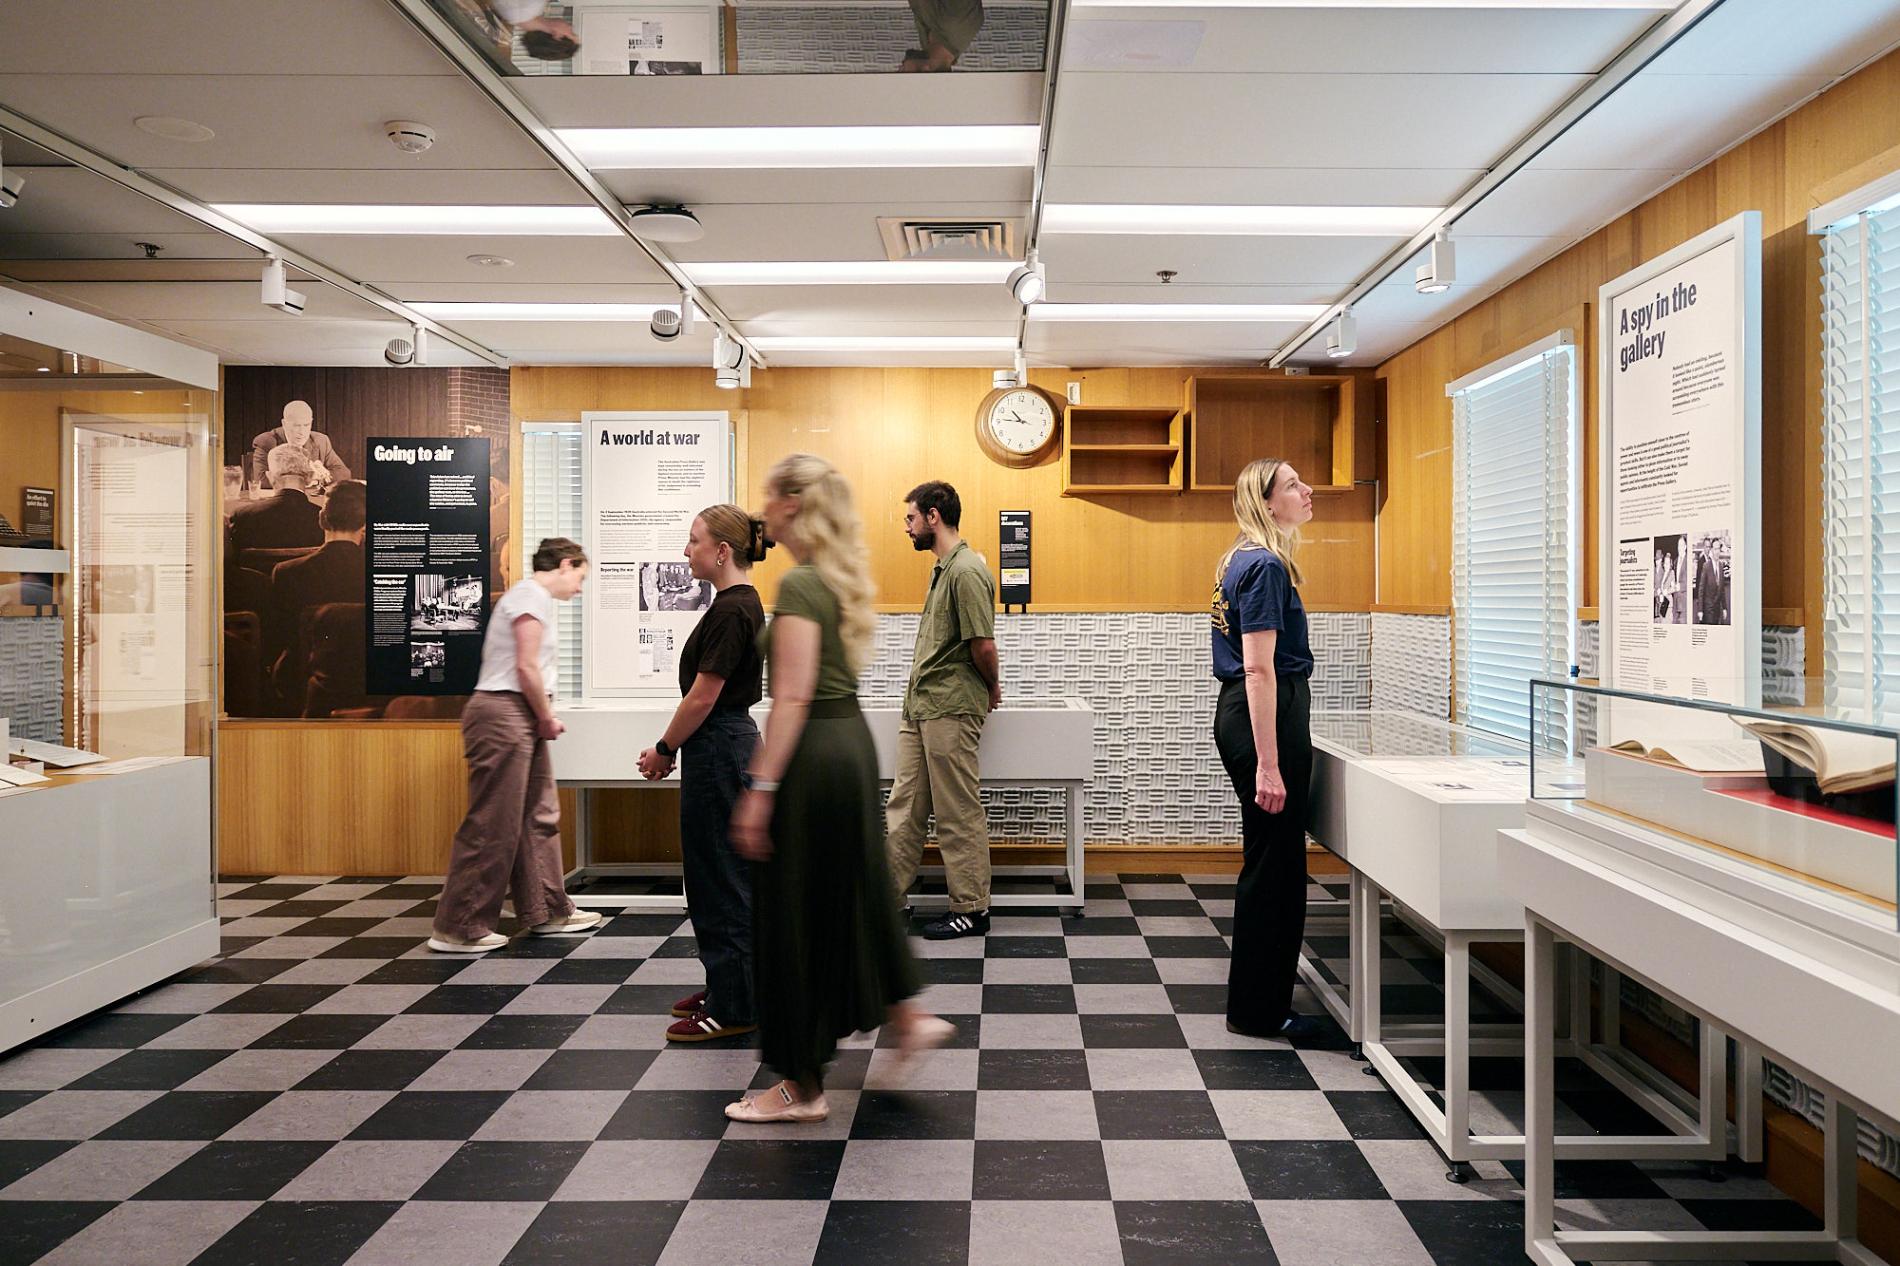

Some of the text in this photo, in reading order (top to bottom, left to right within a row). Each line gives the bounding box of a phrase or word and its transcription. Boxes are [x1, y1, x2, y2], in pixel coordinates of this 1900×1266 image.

[1620, 282, 1696, 336] A spy in the
[1620, 331, 1665, 372] gallery
[600, 430, 700, 445] A world at war
[374, 445, 454, 465] Going to air
